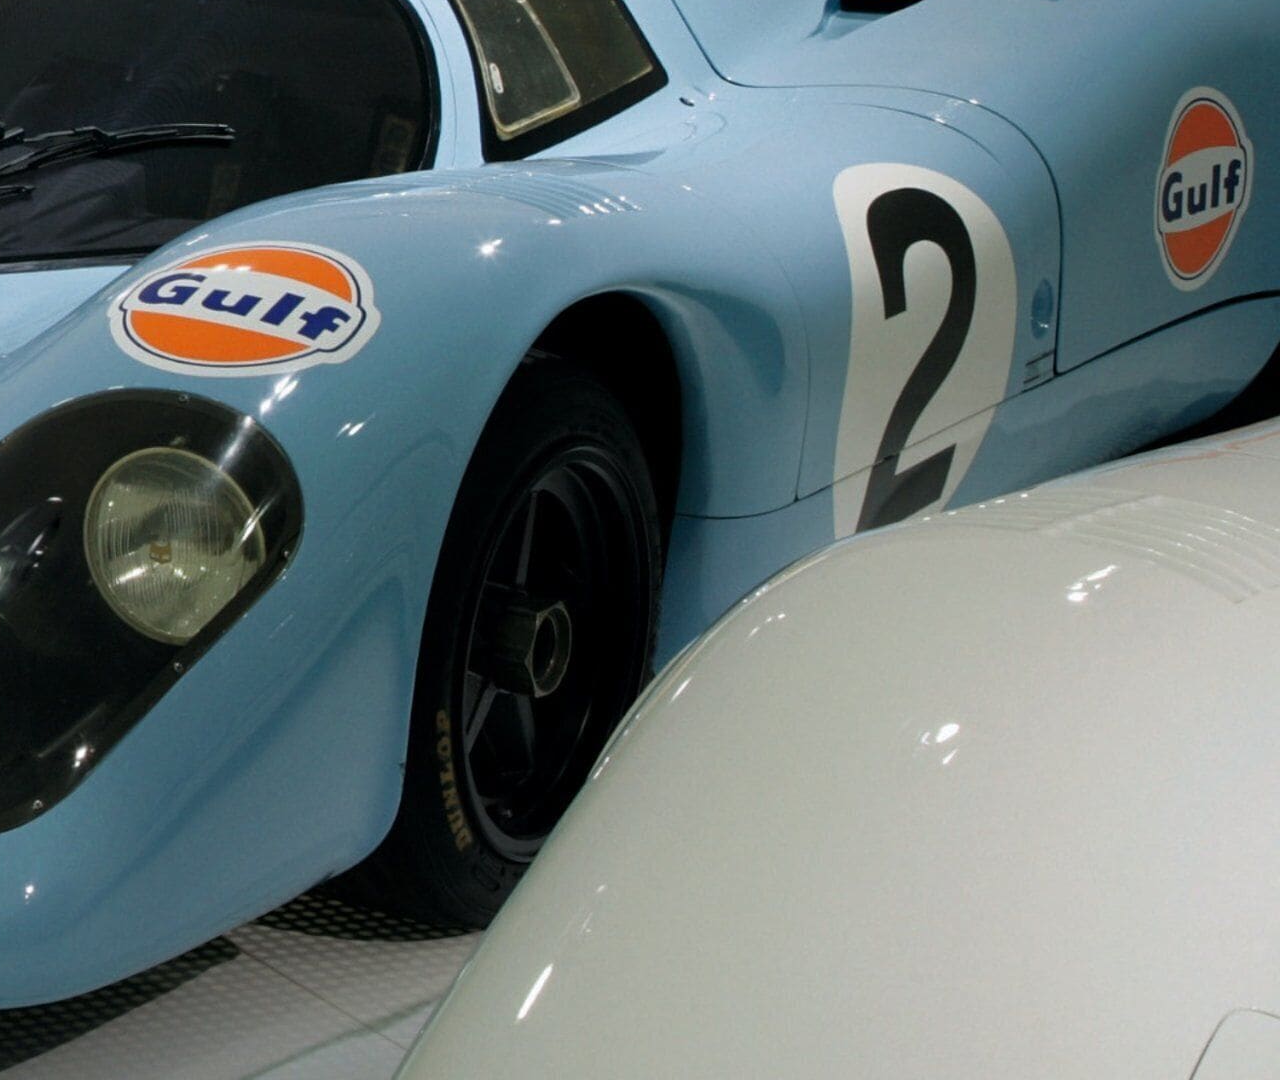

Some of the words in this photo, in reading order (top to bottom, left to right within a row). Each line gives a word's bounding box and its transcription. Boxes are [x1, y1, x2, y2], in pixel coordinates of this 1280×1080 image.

[1161, 158, 1242, 222] Gulf
[138, 272, 351, 341] Gulf
[855, 187, 976, 534] 2
